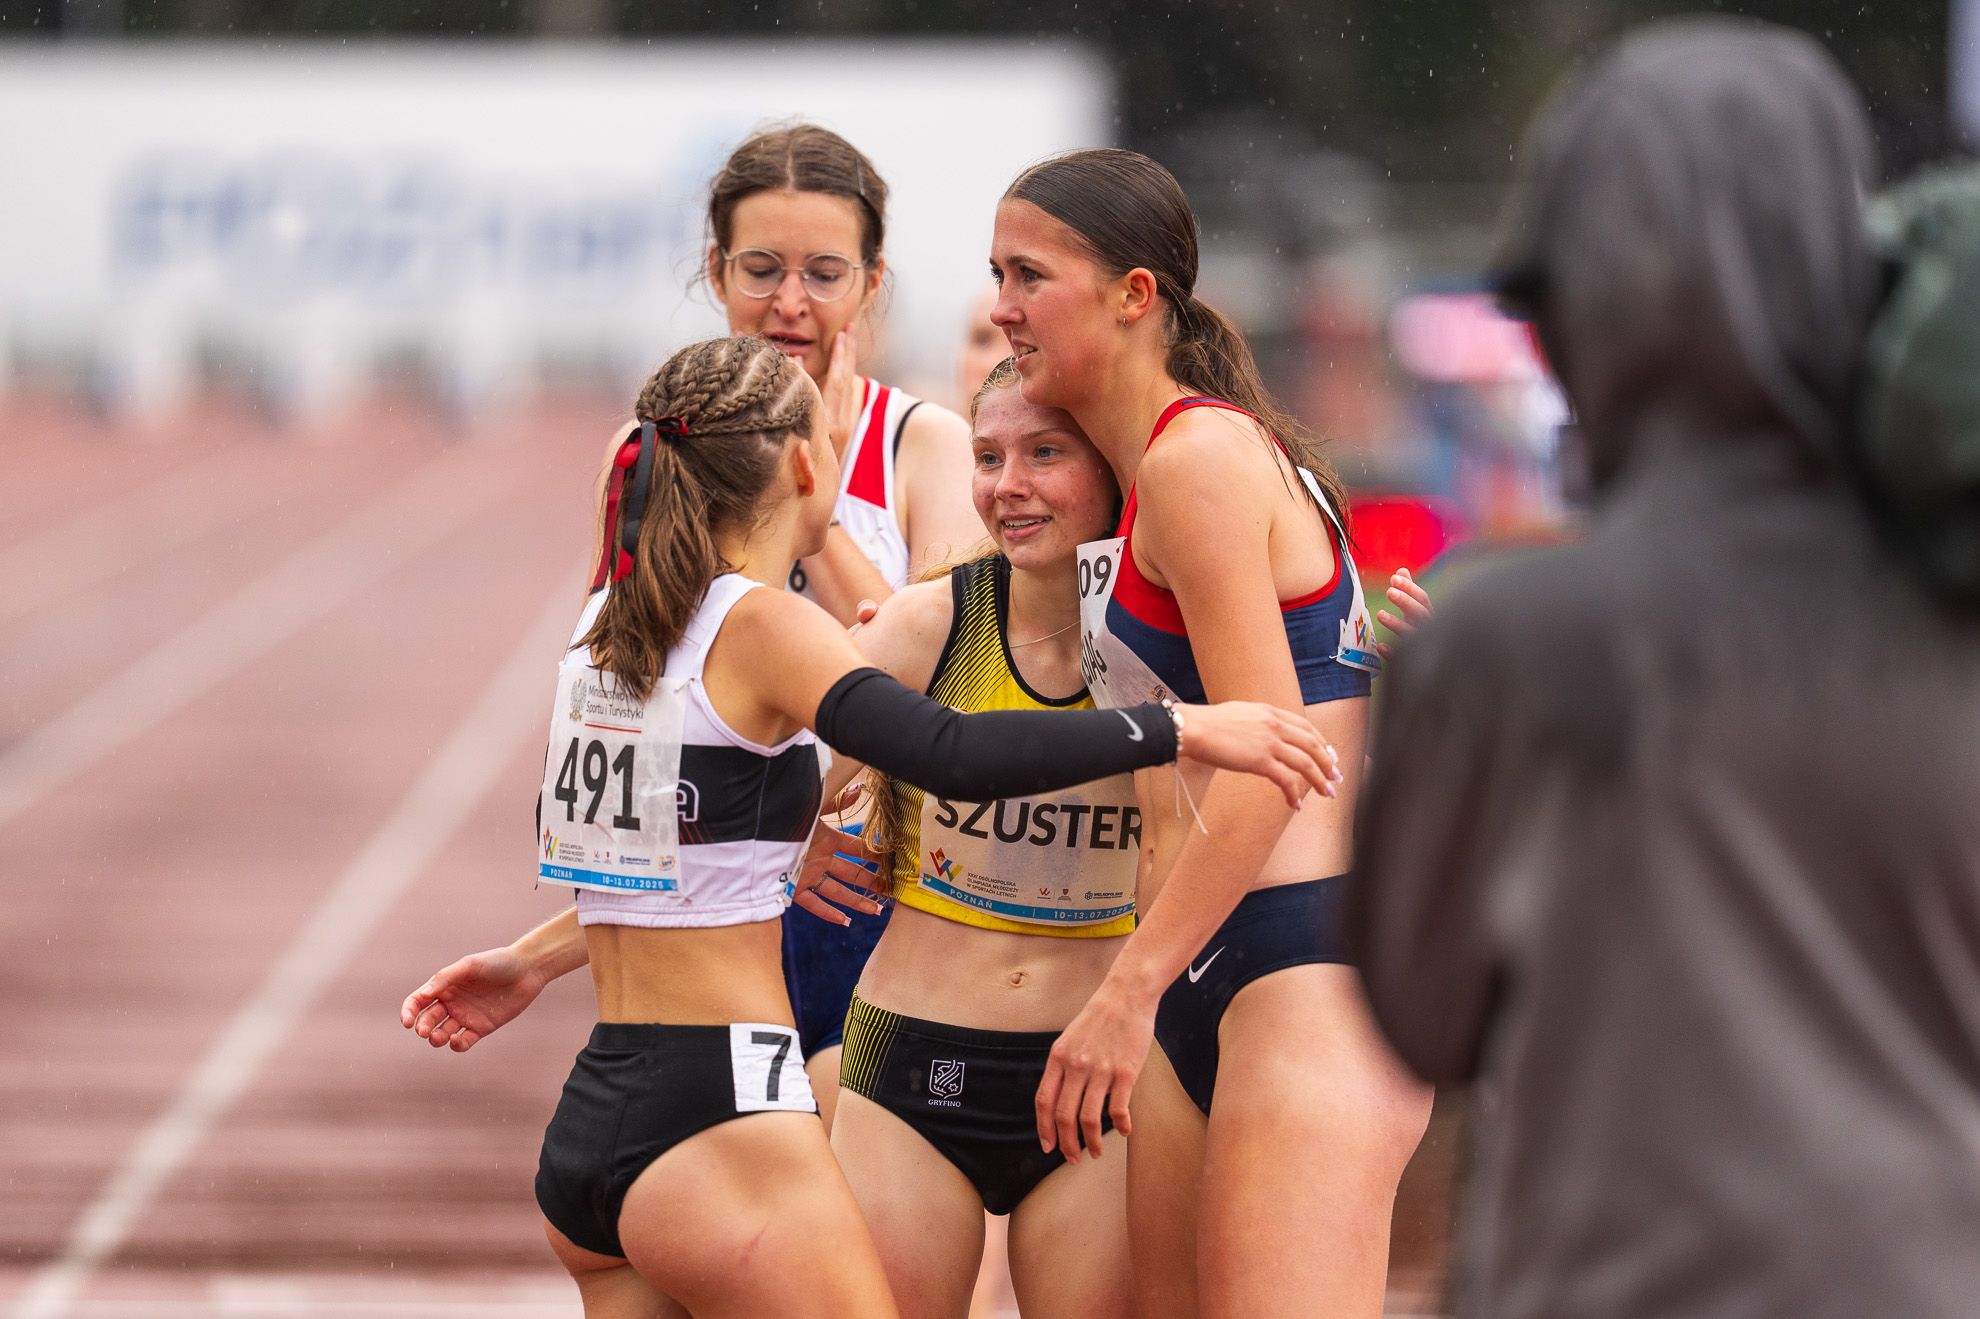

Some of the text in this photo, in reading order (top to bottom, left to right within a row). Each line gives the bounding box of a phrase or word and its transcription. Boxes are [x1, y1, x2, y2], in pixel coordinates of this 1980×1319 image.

[586, 702, 604, 716] Sportu
[609, 704, 644, 720] Turystyki
[555, 737, 640, 831] 491
[934, 797, 1142, 850] SZUSTER
[550, 867, 664, 889] POZNAŃ 10-13.07.2025
[972, 884, 996, 895] SPORTACH
[996, 890, 1017, 899] LETNICH
[950, 888, 1128, 920] POZNAŃ 10-13.07.2025
[751, 1031, 792, 1102] 7
[928, 1098, 961, 1108] GRYFINO
